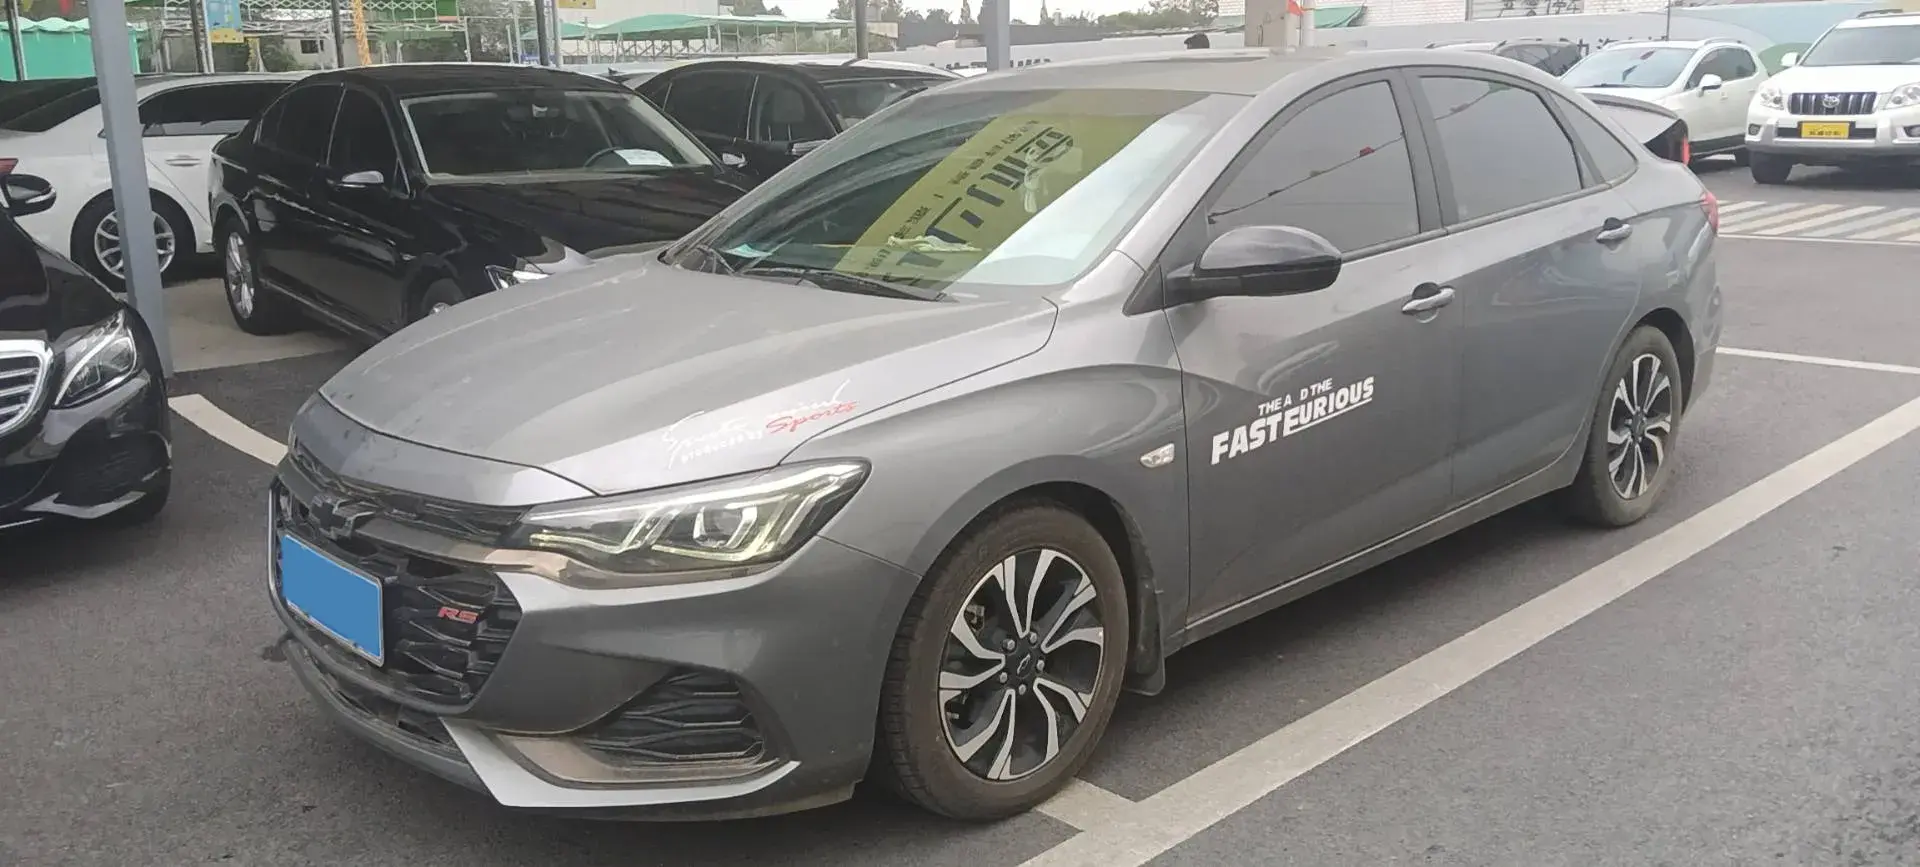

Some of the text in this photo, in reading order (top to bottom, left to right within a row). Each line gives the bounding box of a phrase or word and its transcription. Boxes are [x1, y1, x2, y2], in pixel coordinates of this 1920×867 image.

[1258, 397, 1282, 417] THE
[1310, 377, 1333, 396] THE
[765, 401, 857, 433] Sports
[1211, 414, 1283, 466] FAST
[437, 606, 479, 625] RS
